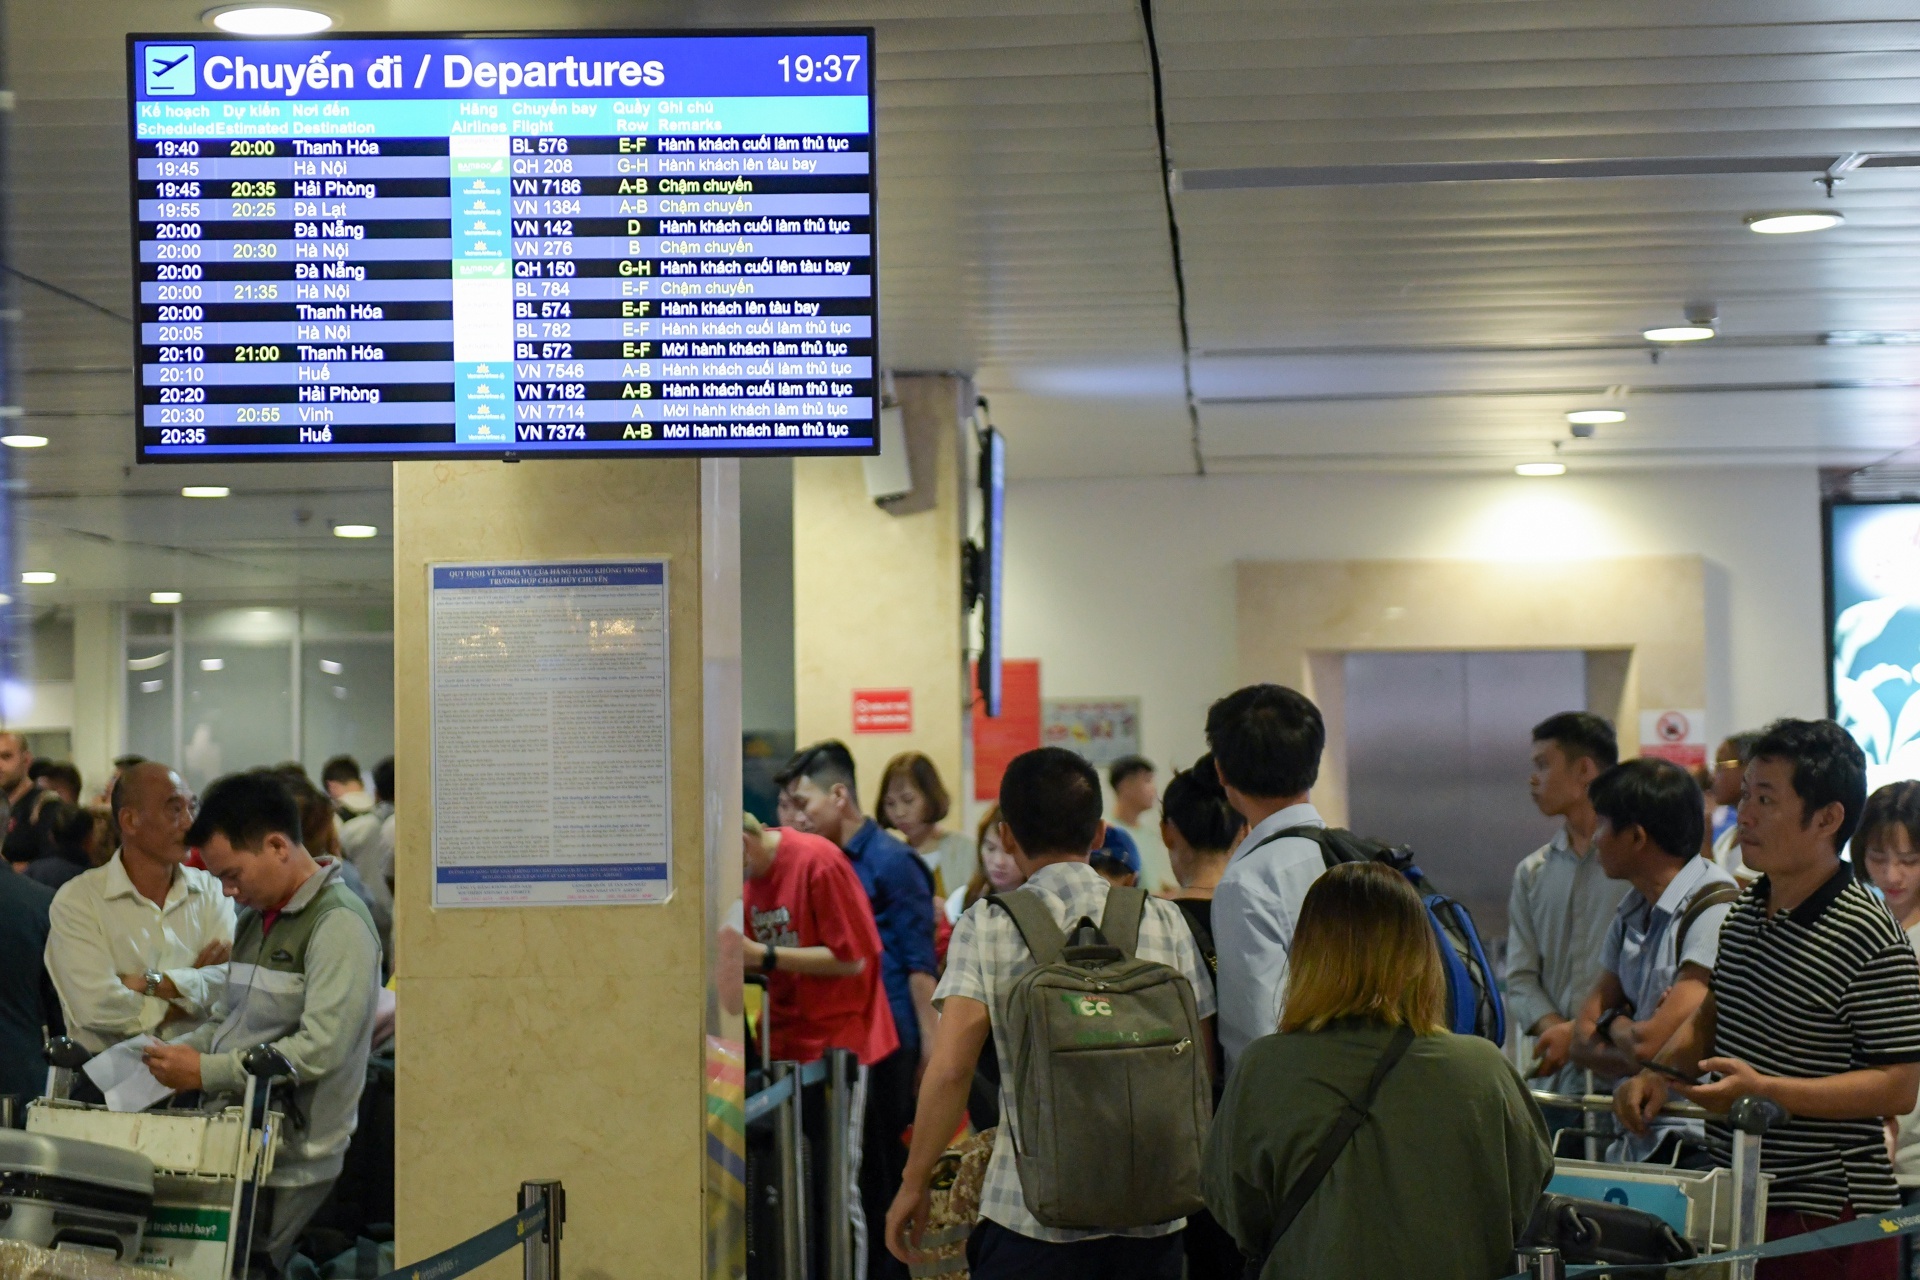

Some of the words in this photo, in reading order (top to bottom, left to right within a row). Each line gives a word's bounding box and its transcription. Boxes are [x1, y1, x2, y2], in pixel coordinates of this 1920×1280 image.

[202, 51, 354, 96] Chuyến
[367, 54, 403, 88] đi
[414, 54, 432, 89] /
[444, 54, 665, 96] Departures
[777, 54, 861, 83] 19:37
[165, 103, 210, 121] hoạch
[250, 102, 281, 117] kiến
[323, 102, 349, 117] đến
[460, 103, 498, 118] Hãng
[512, 99, 567, 117] Chuyến
[571, 102, 597, 118] bay
[658, 101, 683, 115] Ghi
[687, 101, 714, 115] chú
[137, 122, 215, 135] Scheduled
[216, 122, 288, 135] Estimated
[293, 121, 375, 135] Destination
[451, 120, 508, 134] Airlines
[512, 120, 554, 136] Flight
[616, 119, 648, 132] Row
[658, 118, 722, 132] Remarks
[156, 141, 198, 156] 19:40
[231, 140, 274, 155] 20:00
[293, 139, 341, 155] Thanh
[348, 139, 378, 154] Hóa
[513, 138, 534, 153] BL
[539, 138, 567, 153] 576
[620, 137, 646, 152] E-F
[659, 138, 694, 151] Hành
[699, 137, 739, 151] khách
[743, 134, 770, 150] cuối
[775, 137, 799, 150] làm
[803, 136, 823, 150] thủ
[828, 137, 848, 152] tục
[157, 161, 199, 176] 19:45
[295, 160, 316, 175] Hà
[321, 160, 347, 178] Nội
[513, 159, 538, 175] QH
[544, 158, 572, 173] 208
[618, 158, 648, 173] G-H
[659, 158, 695, 172] Hành
[699, 157, 739, 171] khách
[744, 158, 763, 171] lên
[767, 158, 788, 171] tàu
[793, 157, 817, 174] bay
[157, 183, 199, 197] 19:45
[232, 181, 275, 196] 20:35
[295, 181, 320, 196] Hải
[326, 180, 374, 199] Phòng
[513, 179, 537, 194] VN
[543, 179, 580, 194] 7186
[619, 178, 647, 194] A-B
[659, 179, 699, 194] Chậm
[704, 176, 752, 195] chuyến
[158, 202, 200, 218] 19:55
[233, 202, 275, 217] 20:25
[294, 201, 317, 217] Đà
[322, 201, 346, 219] Lạt
[514, 200, 537, 215] VN
[544, 199, 581, 215] 1384
[619, 199, 647, 214] A-B
[157, 224, 200, 238] 20:00
[295, 222, 317, 237] Đà
[323, 220, 363, 240] Nẵng
[514, 220, 538, 235] VN
[545, 220, 572, 235] 142
[629, 220, 640, 235] D
[158, 243, 201, 259] 20:00
[234, 243, 276, 258] 20:30
[296, 243, 318, 258] Hà
[323, 242, 348, 260] Nội
[515, 241, 538, 256] VN
[544, 241, 572, 256] 276
[630, 240, 640, 255] B
[158, 265, 201, 279] 20:00
[296, 263, 318, 278] Đà
[324, 261, 364, 281] Nẵng
[515, 261, 540, 277] QH
[547, 261, 574, 276] 150
[620, 261, 650, 275] G-H
[661, 260, 696, 275] Hành
[701, 260, 741, 273] khách
[745, 258, 772, 273] cuối
[777, 260, 796, 273] lên
[800, 259, 821, 272] tàu
[826, 259, 850, 275] bay
[159, 285, 202, 300] 20:00
[235, 284, 277, 299] 21:35
[297, 284, 318, 299] Hà
[324, 283, 349, 302] Nội
[516, 282, 537, 297] BL
[542, 282, 570, 297] 784
[159, 305, 202, 320] 20:00
[297, 304, 345, 319] Thanh
[351, 304, 382, 319] Hóa
[517, 303, 537, 318] BL
[542, 302, 570, 318] 574
[160, 326, 203, 341] 20:05
[298, 325, 319, 340] Hà
[325, 325, 350, 342] Nội
[517, 323, 537, 338] BL
[543, 322, 571, 338] 782
[160, 346, 203, 362] 20:10
[236, 346, 279, 361] 21:00
[298, 345, 346, 361] Thanh
[352, 345, 383, 360] Hóa
[517, 344, 538, 358] BL
[543, 343, 571, 358] 572
[160, 367, 204, 382] 20:10
[299, 364, 330, 381] Huế
[517, 363, 540, 379] VN
[546, 363, 584, 378] 7546
[161, 387, 204, 403] 20:20
[300, 384, 324, 402] Hải
[330, 386, 379, 404] Phòng
[518, 384, 541, 399] VN
[547, 384, 584, 399] 7182
[161, 408, 204, 423] 20:30
[237, 407, 280, 423] 20:55
[299, 406, 333, 421] Vinh
[518, 404, 541, 420] VN
[547, 404, 584, 419] 7714
[162, 429, 205, 443] 20:35
[300, 426, 331, 442] Huế
[518, 425, 541, 439] VN
[547, 425, 585, 439] 7374
